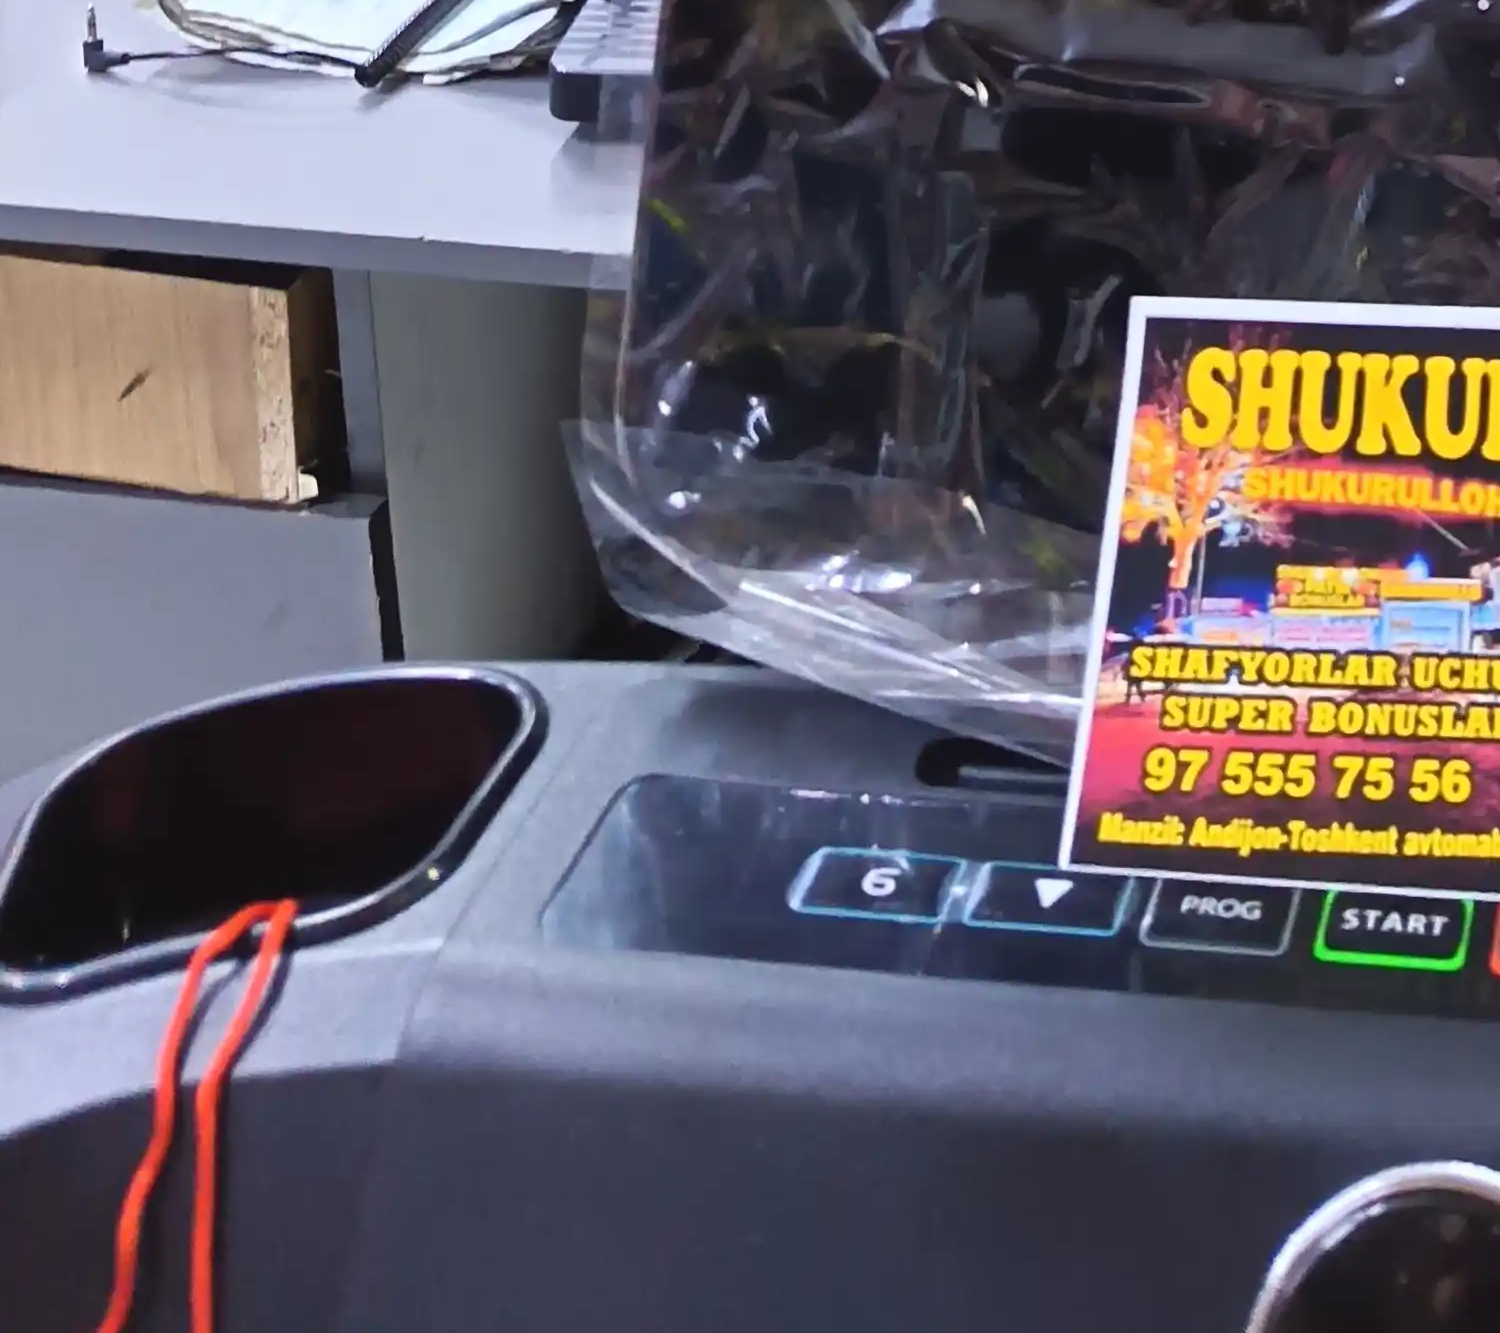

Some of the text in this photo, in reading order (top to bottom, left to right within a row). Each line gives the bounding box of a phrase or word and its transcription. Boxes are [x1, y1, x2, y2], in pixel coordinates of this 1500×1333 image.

[1129, 645, 1398, 687] SHAFYORLAR
[1162, 694, 1295, 732] SUPER
[1144, 746, 1210, 792] 97
[1220, 750, 1317, 798] 555
[1332, 755, 1395, 801] 75
[1408, 758, 1472, 803] 56
[1179, 894, 1263, 921] PROG
[1341, 907, 1451, 938] START
